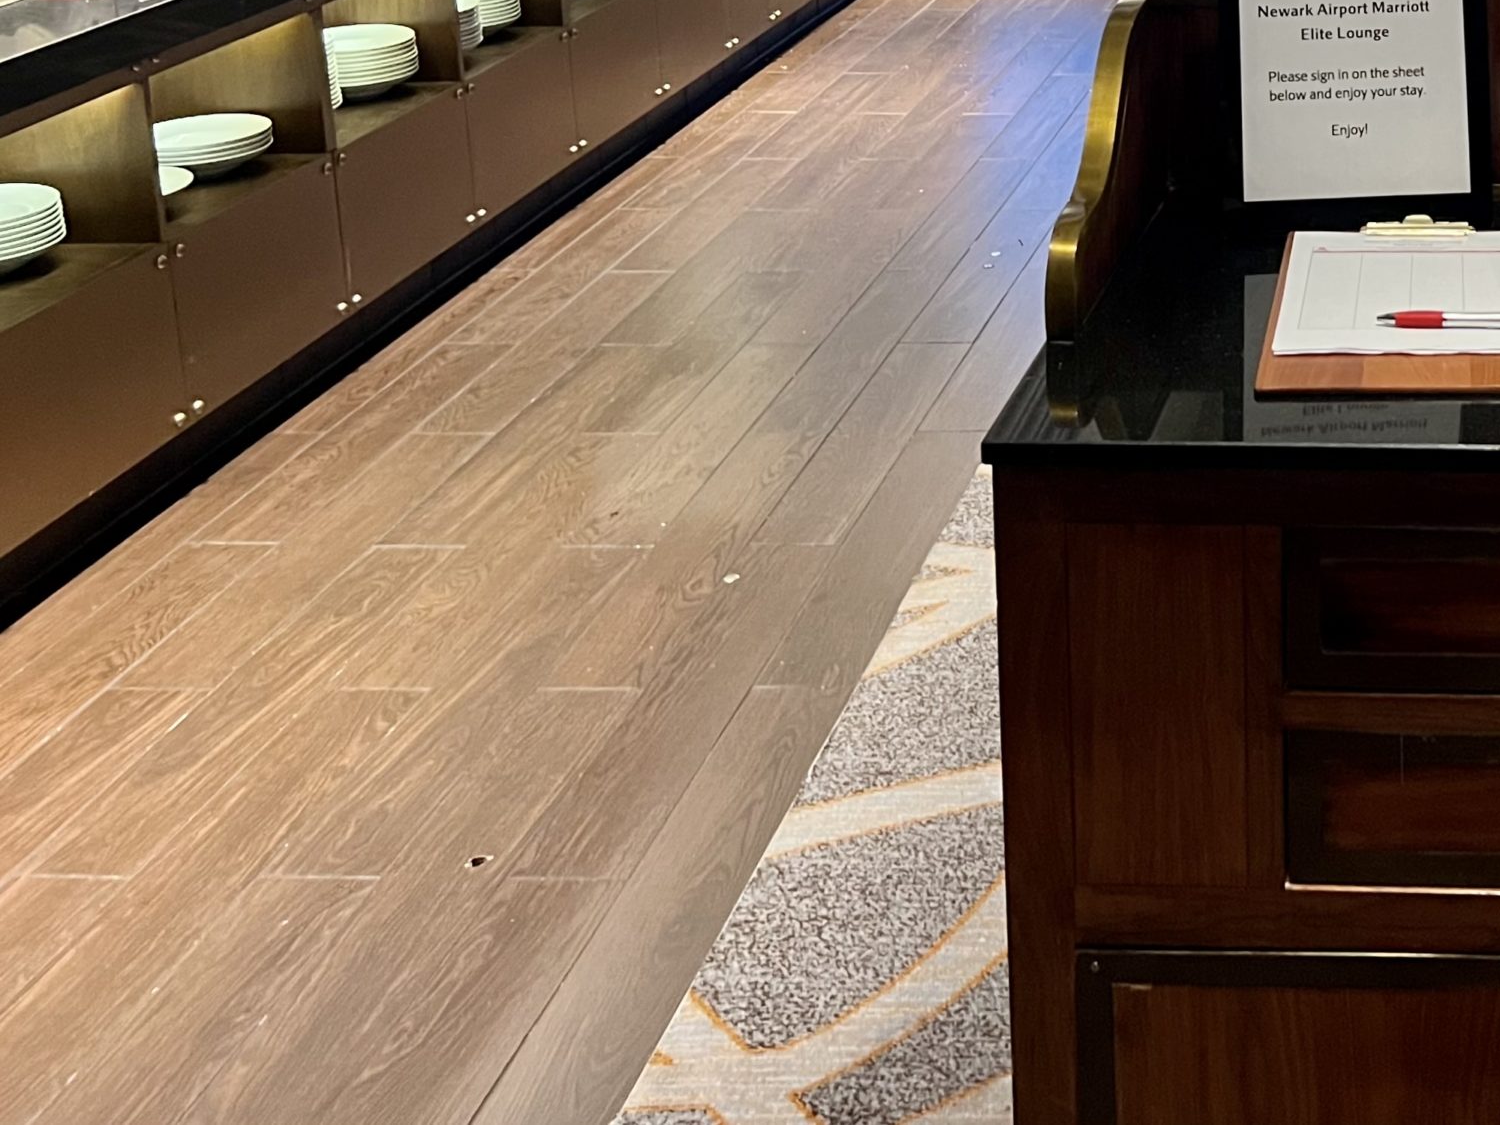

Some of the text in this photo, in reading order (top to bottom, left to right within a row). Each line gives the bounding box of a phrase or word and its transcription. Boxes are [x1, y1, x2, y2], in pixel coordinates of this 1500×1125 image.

[1257, 0, 1430, 19] Newark Airport Marriott
[1300, 26, 1390, 42] Elite Lounge
[1268, 65, 1426, 84] Please sign in on the sheet
[1269, 84, 1427, 102] below and enjoy your stay.
[1331, 122, 1369, 139] Enjoy!
